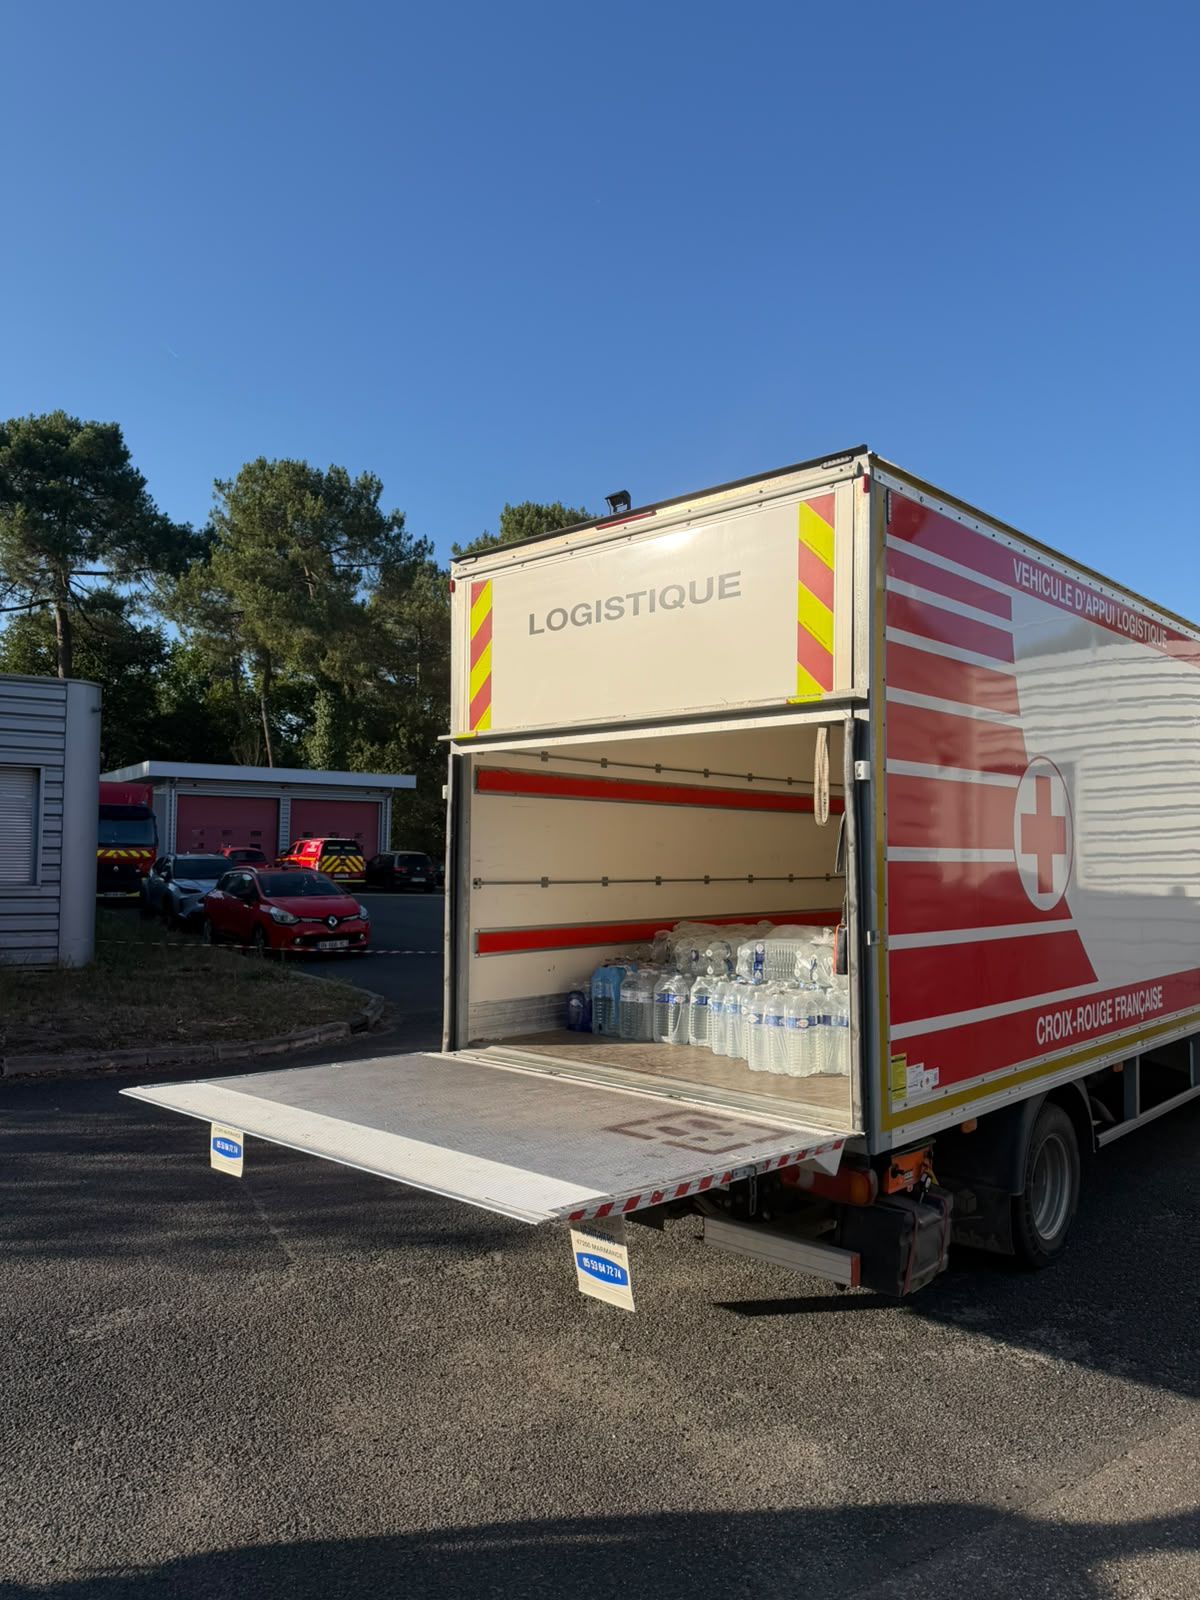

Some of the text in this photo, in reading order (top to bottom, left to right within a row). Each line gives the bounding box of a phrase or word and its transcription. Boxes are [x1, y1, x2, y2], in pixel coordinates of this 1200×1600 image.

[529, 570, 742, 635] LOGISTIQUE
[1013, 558, 1168, 648] VEHICULE D'APPUI LOGISTIQUE
[1036, 985, 1164, 1045] CROIX-ROUGE FRANÇAISE
